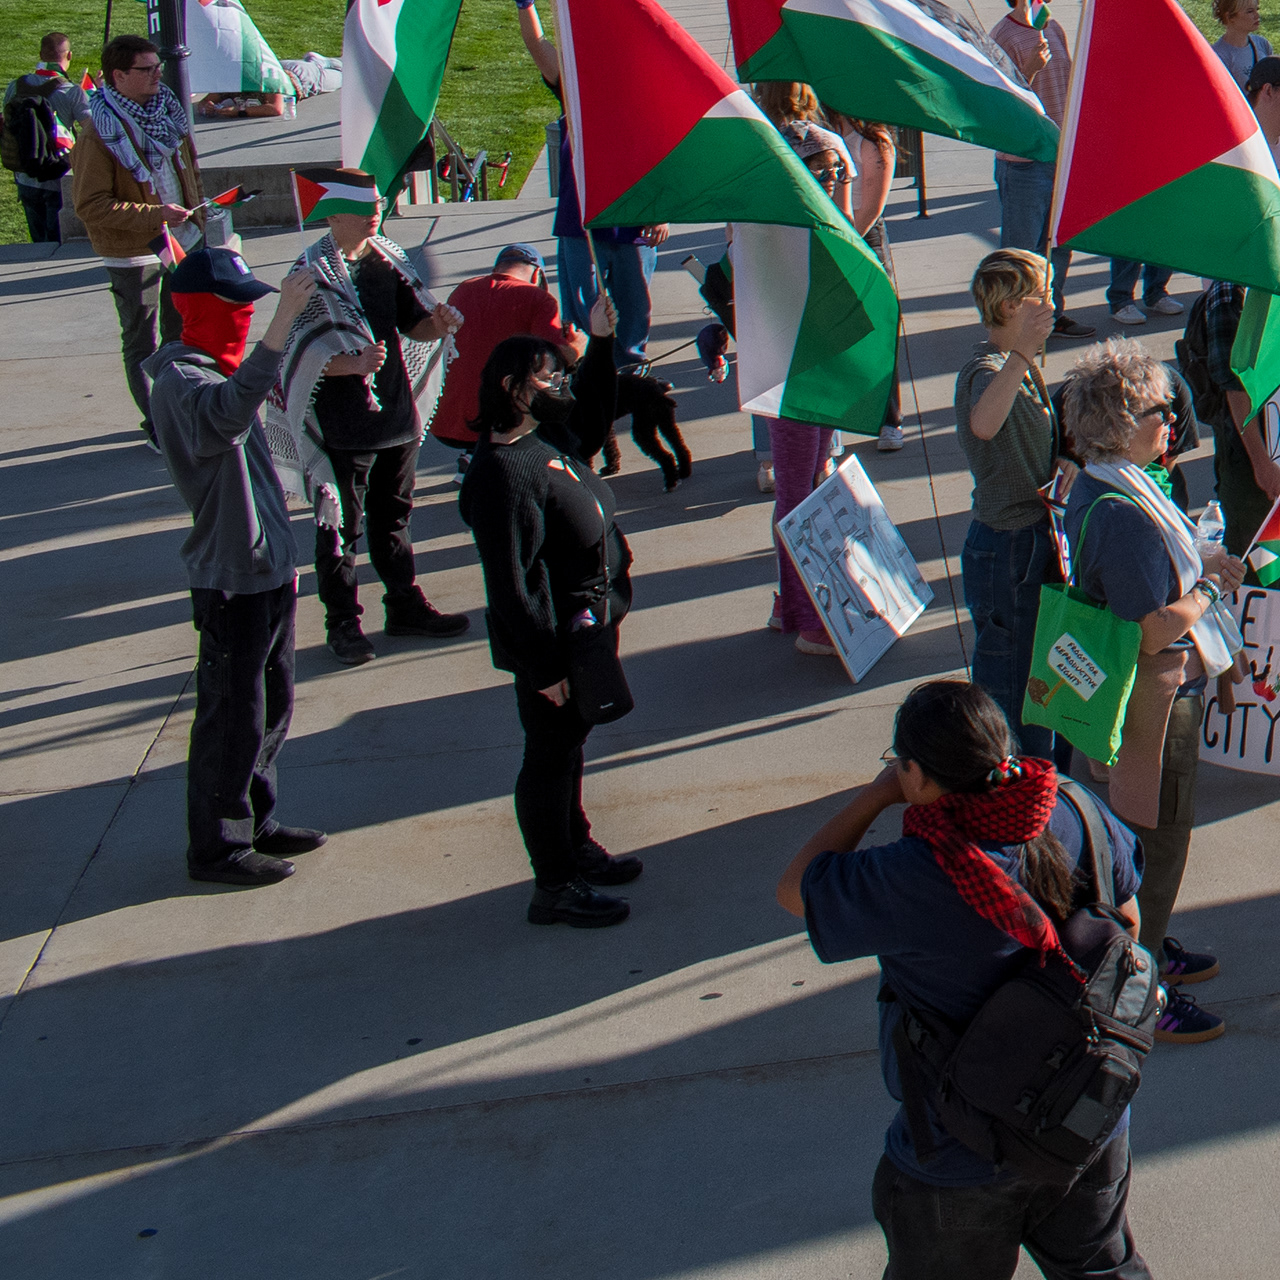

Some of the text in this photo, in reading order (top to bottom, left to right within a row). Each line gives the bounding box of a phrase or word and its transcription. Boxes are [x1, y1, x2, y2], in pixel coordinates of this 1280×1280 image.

[1055, 646, 1098, 688] REPRODUCTIVE
[1057, 663, 1082, 685] RIGHTS
[1067, 642, 1099, 676] FROGS FOR
